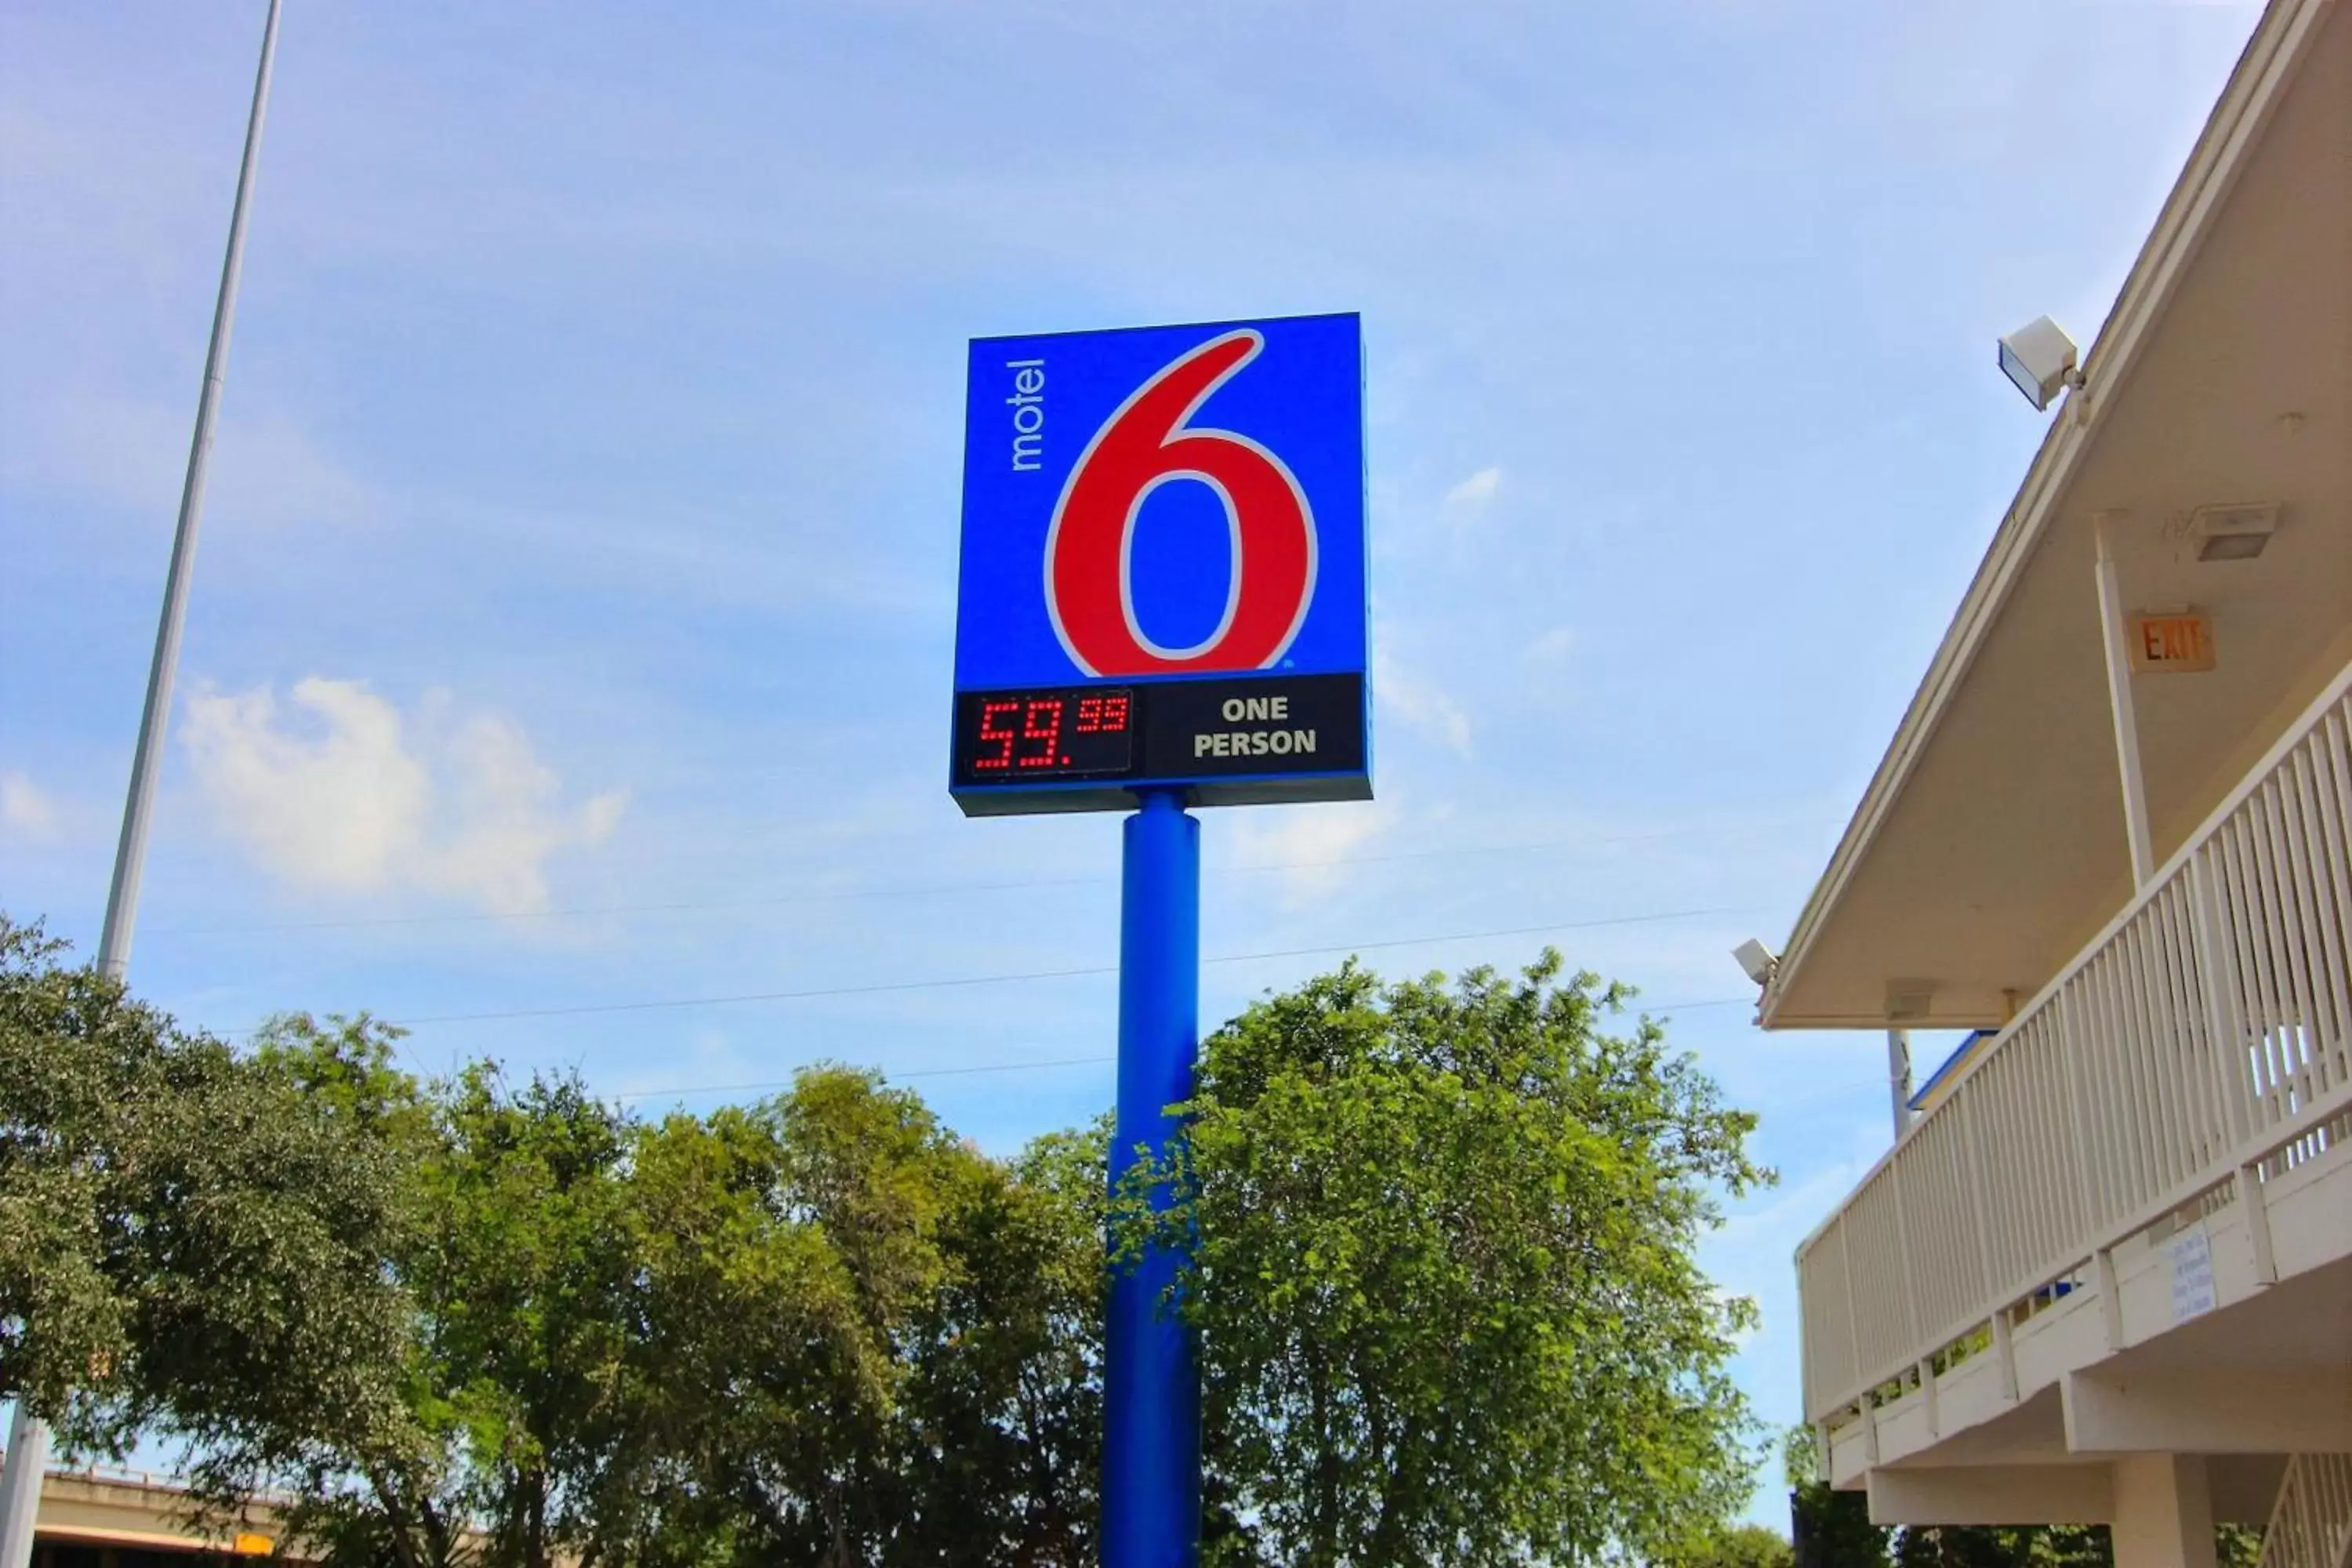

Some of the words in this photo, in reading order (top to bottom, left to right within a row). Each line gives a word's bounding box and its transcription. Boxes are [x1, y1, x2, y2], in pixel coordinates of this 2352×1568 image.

[1007, 360, 1044, 470] motel
[1044, 328, 1319, 677] 6
[2142, 619, 2201, 660] EXIT
[1076, 697, 1128, 731] 99
[1221, 697, 1288, 722] ONE
[1194, 729, 1316, 757] PERSON
